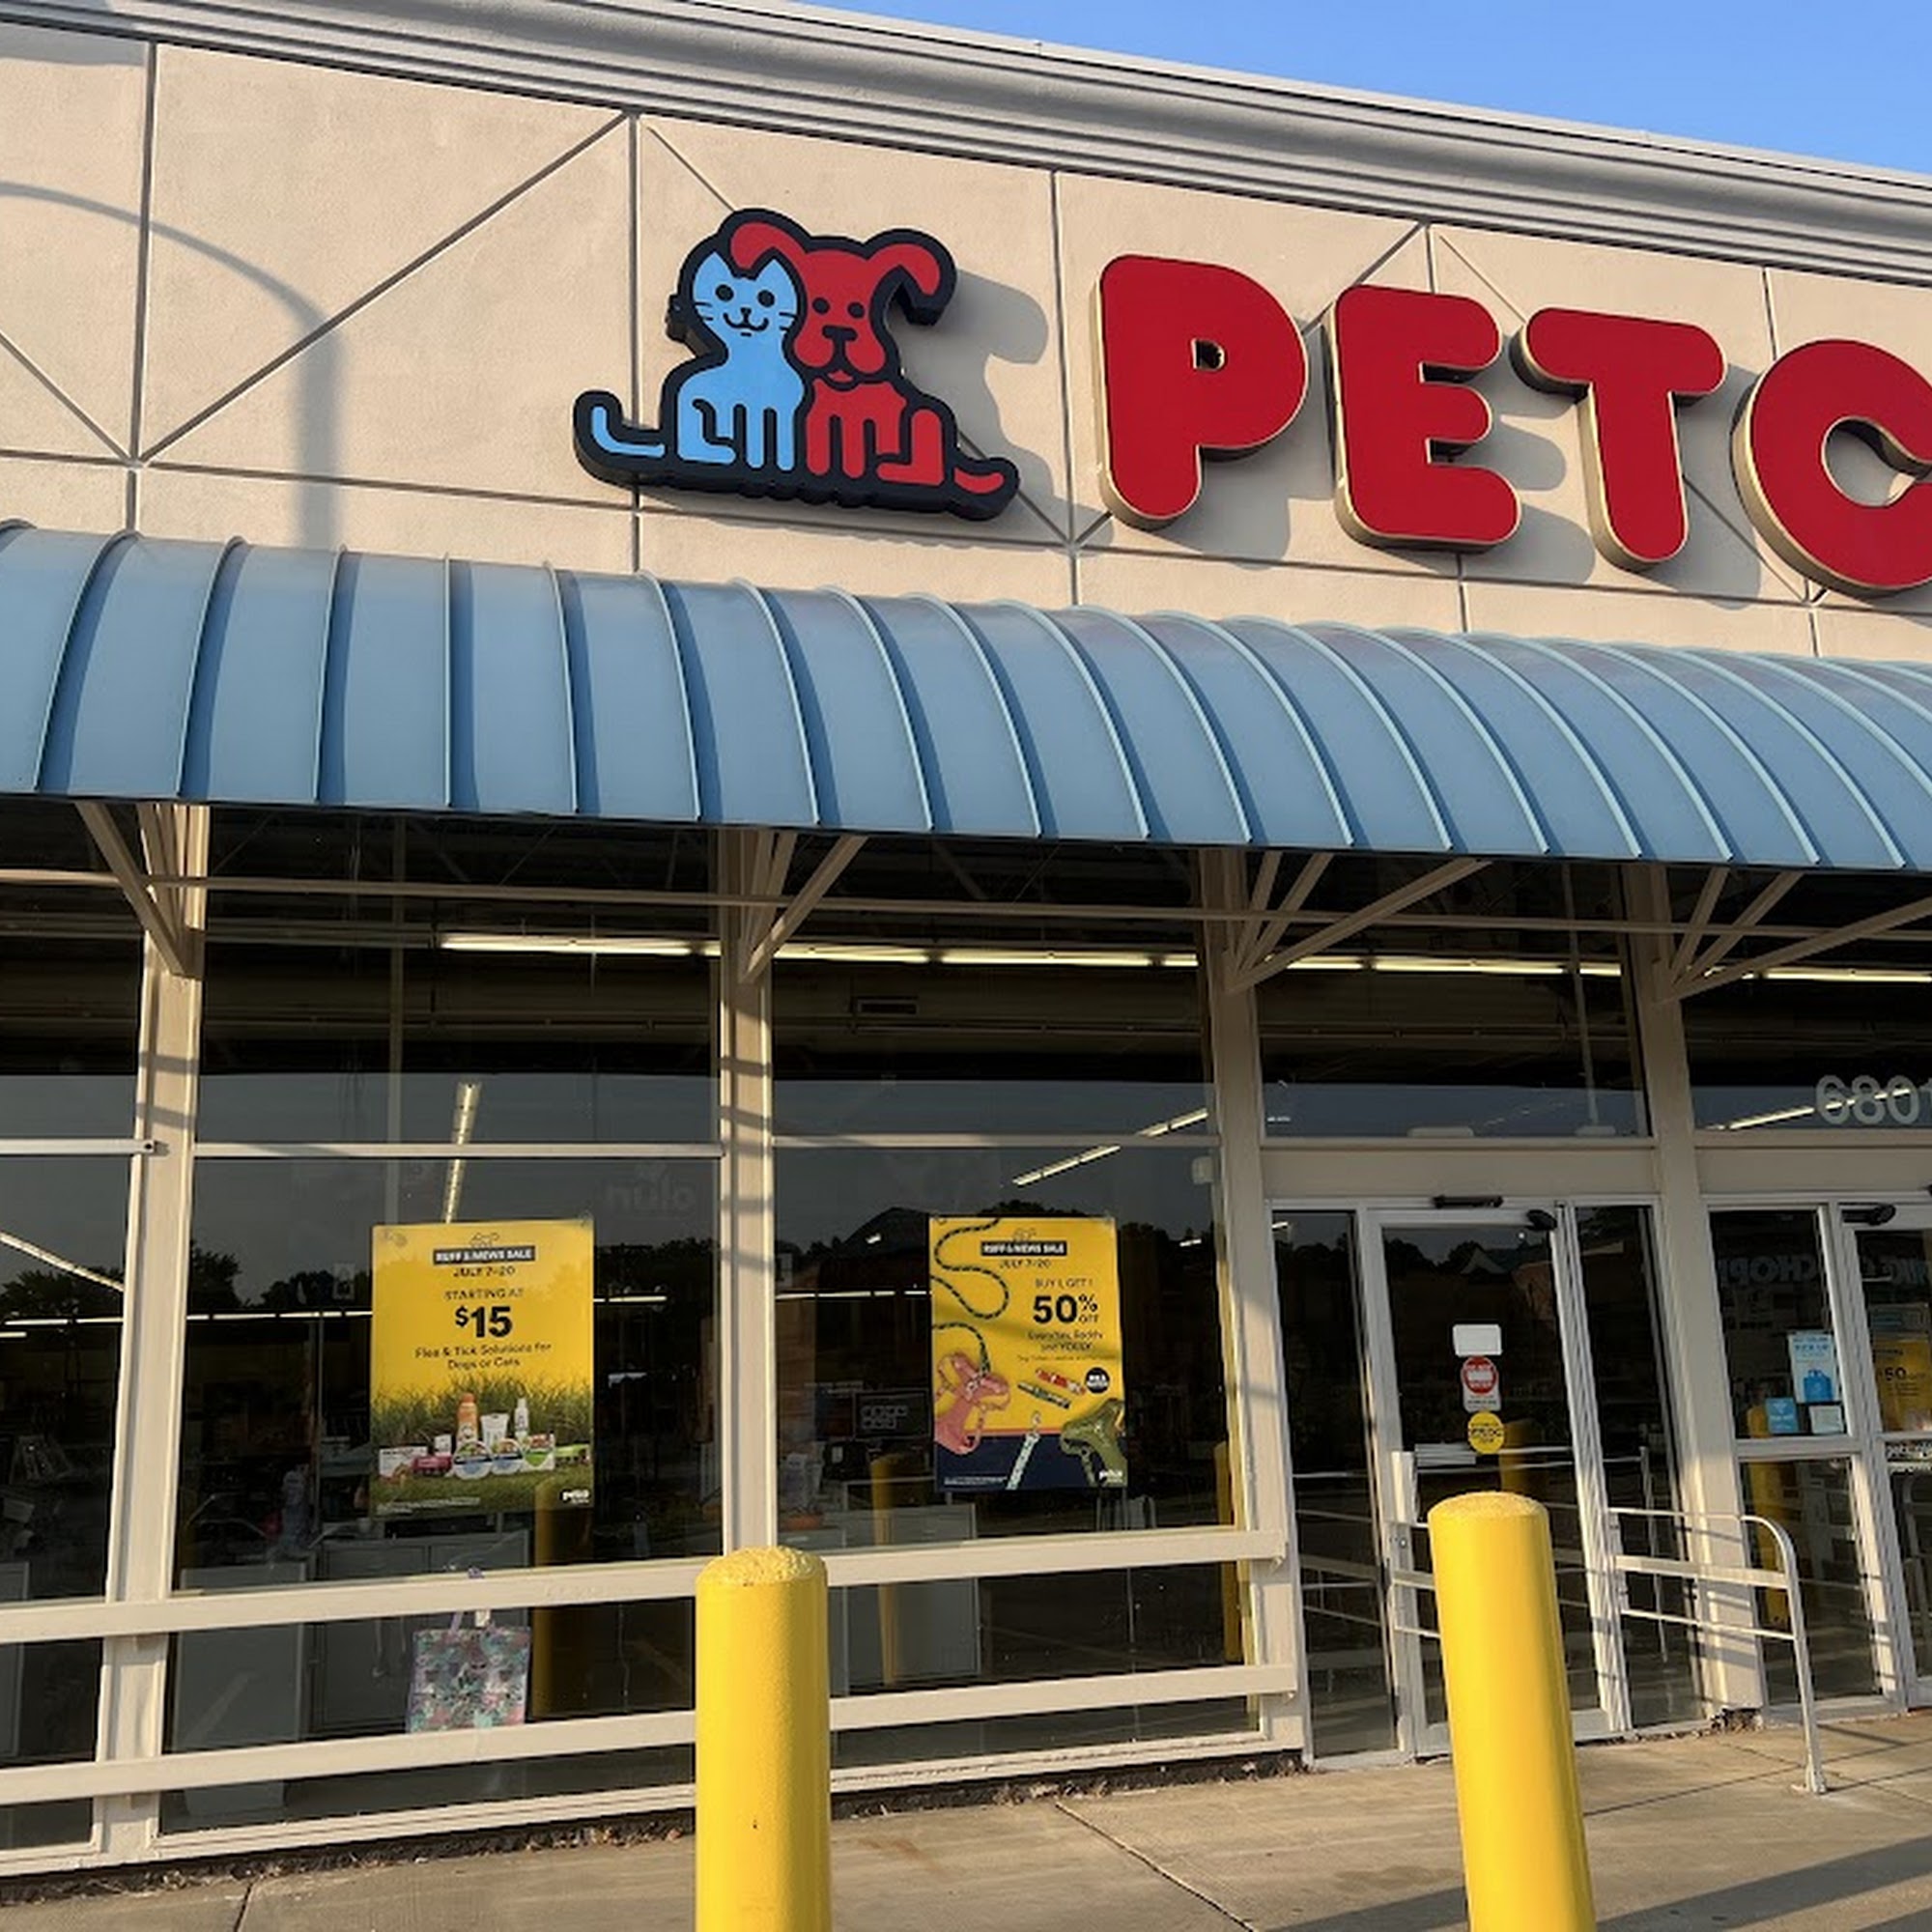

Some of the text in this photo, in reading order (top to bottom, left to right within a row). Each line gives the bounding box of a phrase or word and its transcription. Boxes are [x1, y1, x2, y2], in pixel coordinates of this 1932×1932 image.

[1093, 254, 1932, 593] PETC
[507, 1248, 533, 1260] SALE
[1000, 1259, 1024, 1269] JULY
[453, 1266, 482, 1278] JULY
[1035, 1278, 1055, 1288] BUY
[1066, 1278, 1087, 1288] GET
[443, 1288, 525, 1301] STARTING AT
[455, 1305, 513, 1339] $15
[454, 1345, 477, 1357] Tick
[533, 1342, 552, 1353] for
[447, 1357, 520, 1372] Dogs or Cats
